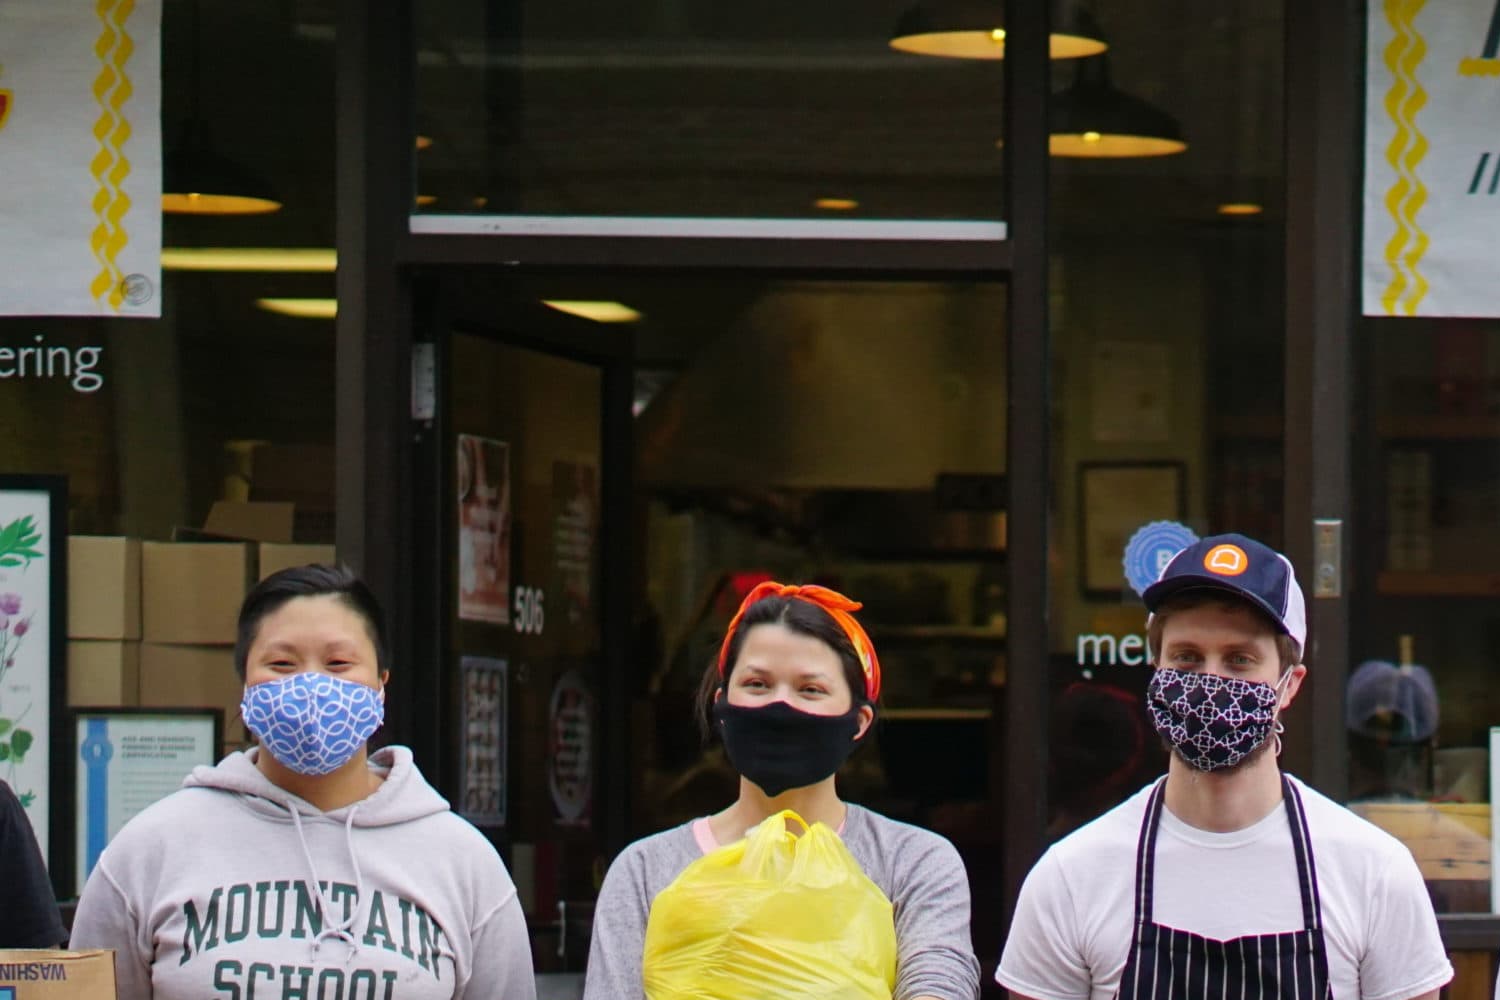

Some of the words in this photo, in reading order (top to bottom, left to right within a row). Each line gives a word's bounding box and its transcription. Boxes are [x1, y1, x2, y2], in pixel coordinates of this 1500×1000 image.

[0, 335, 104, 392] ering
[514, 584, 545, 635] 506
[179, 879, 444, 981] MOUNTAIN
